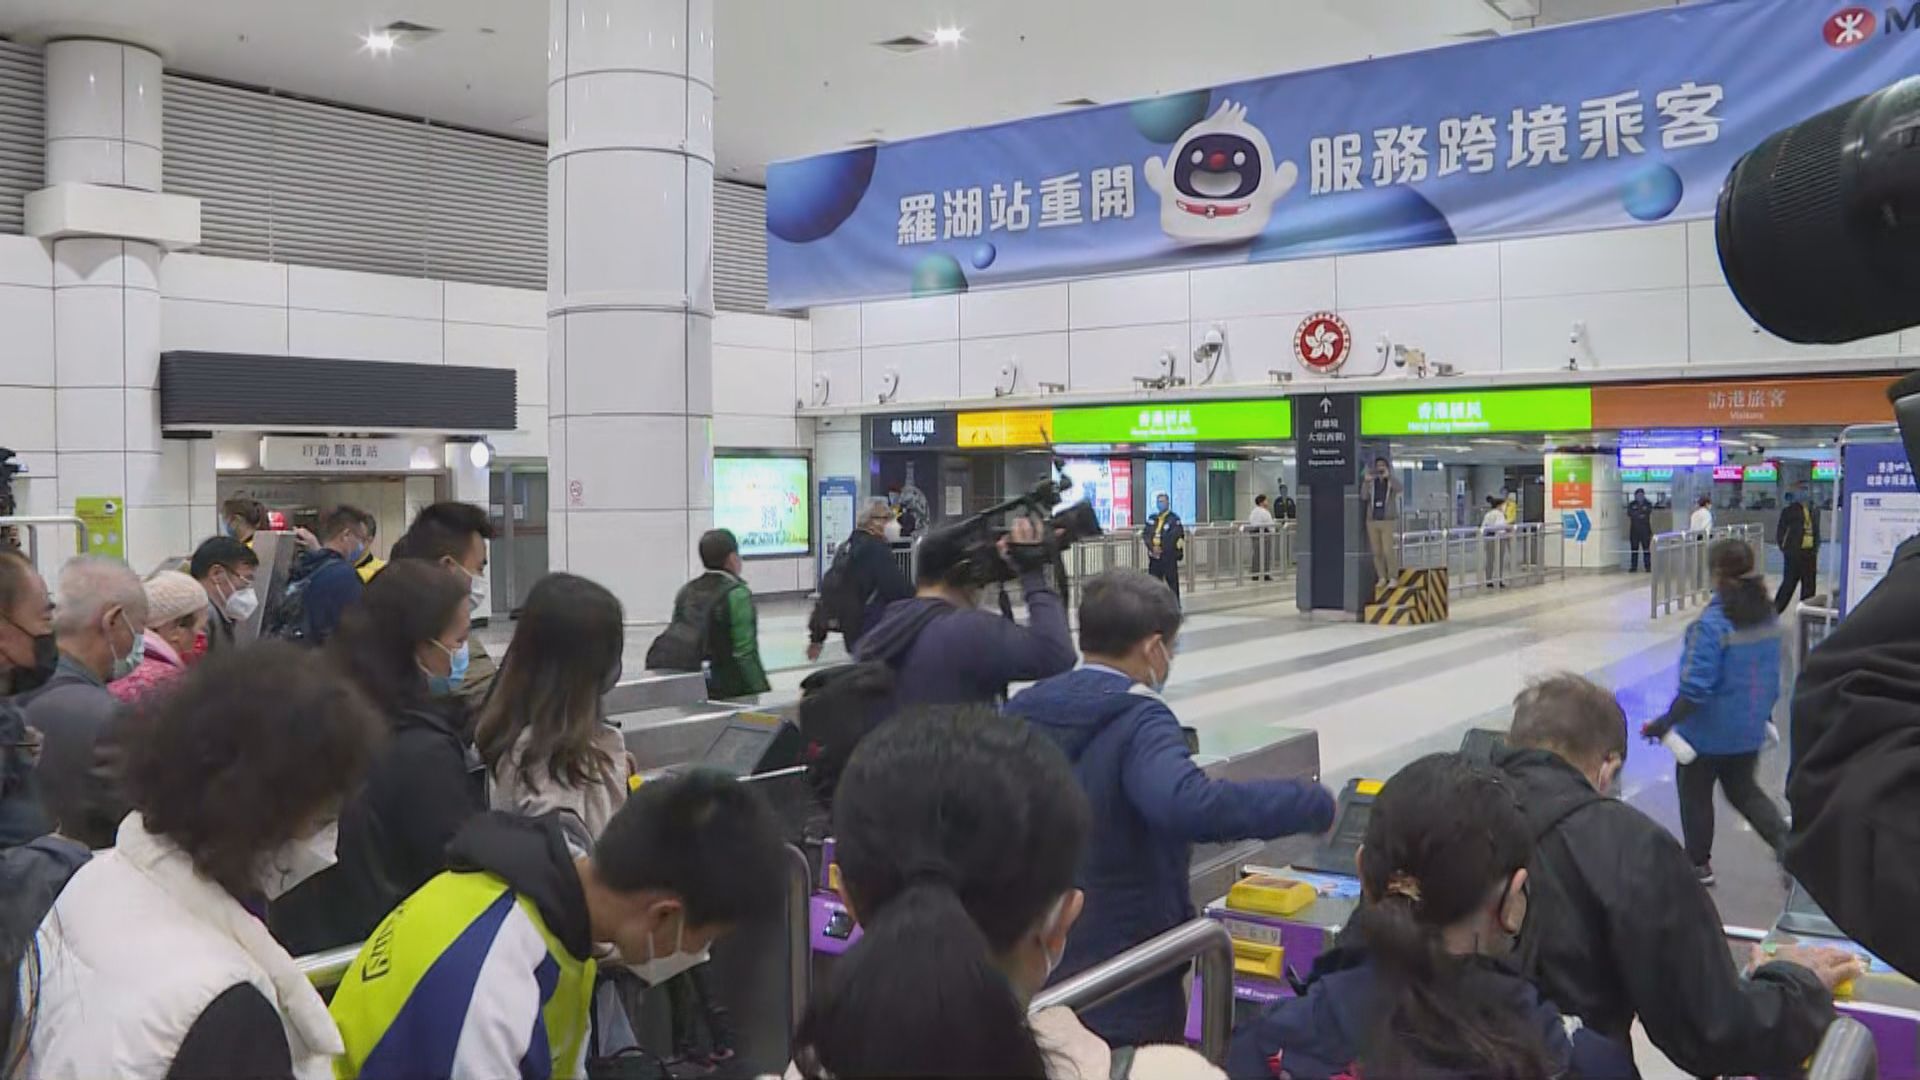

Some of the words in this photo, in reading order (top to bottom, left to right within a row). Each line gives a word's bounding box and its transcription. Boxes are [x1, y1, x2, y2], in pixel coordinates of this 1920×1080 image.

[897, 164, 1136, 246] 羅湖站重開
[1309, 81, 1727, 195] 服務跨境乘客
[1707, 388, 1786, 409] 訪港旅客
